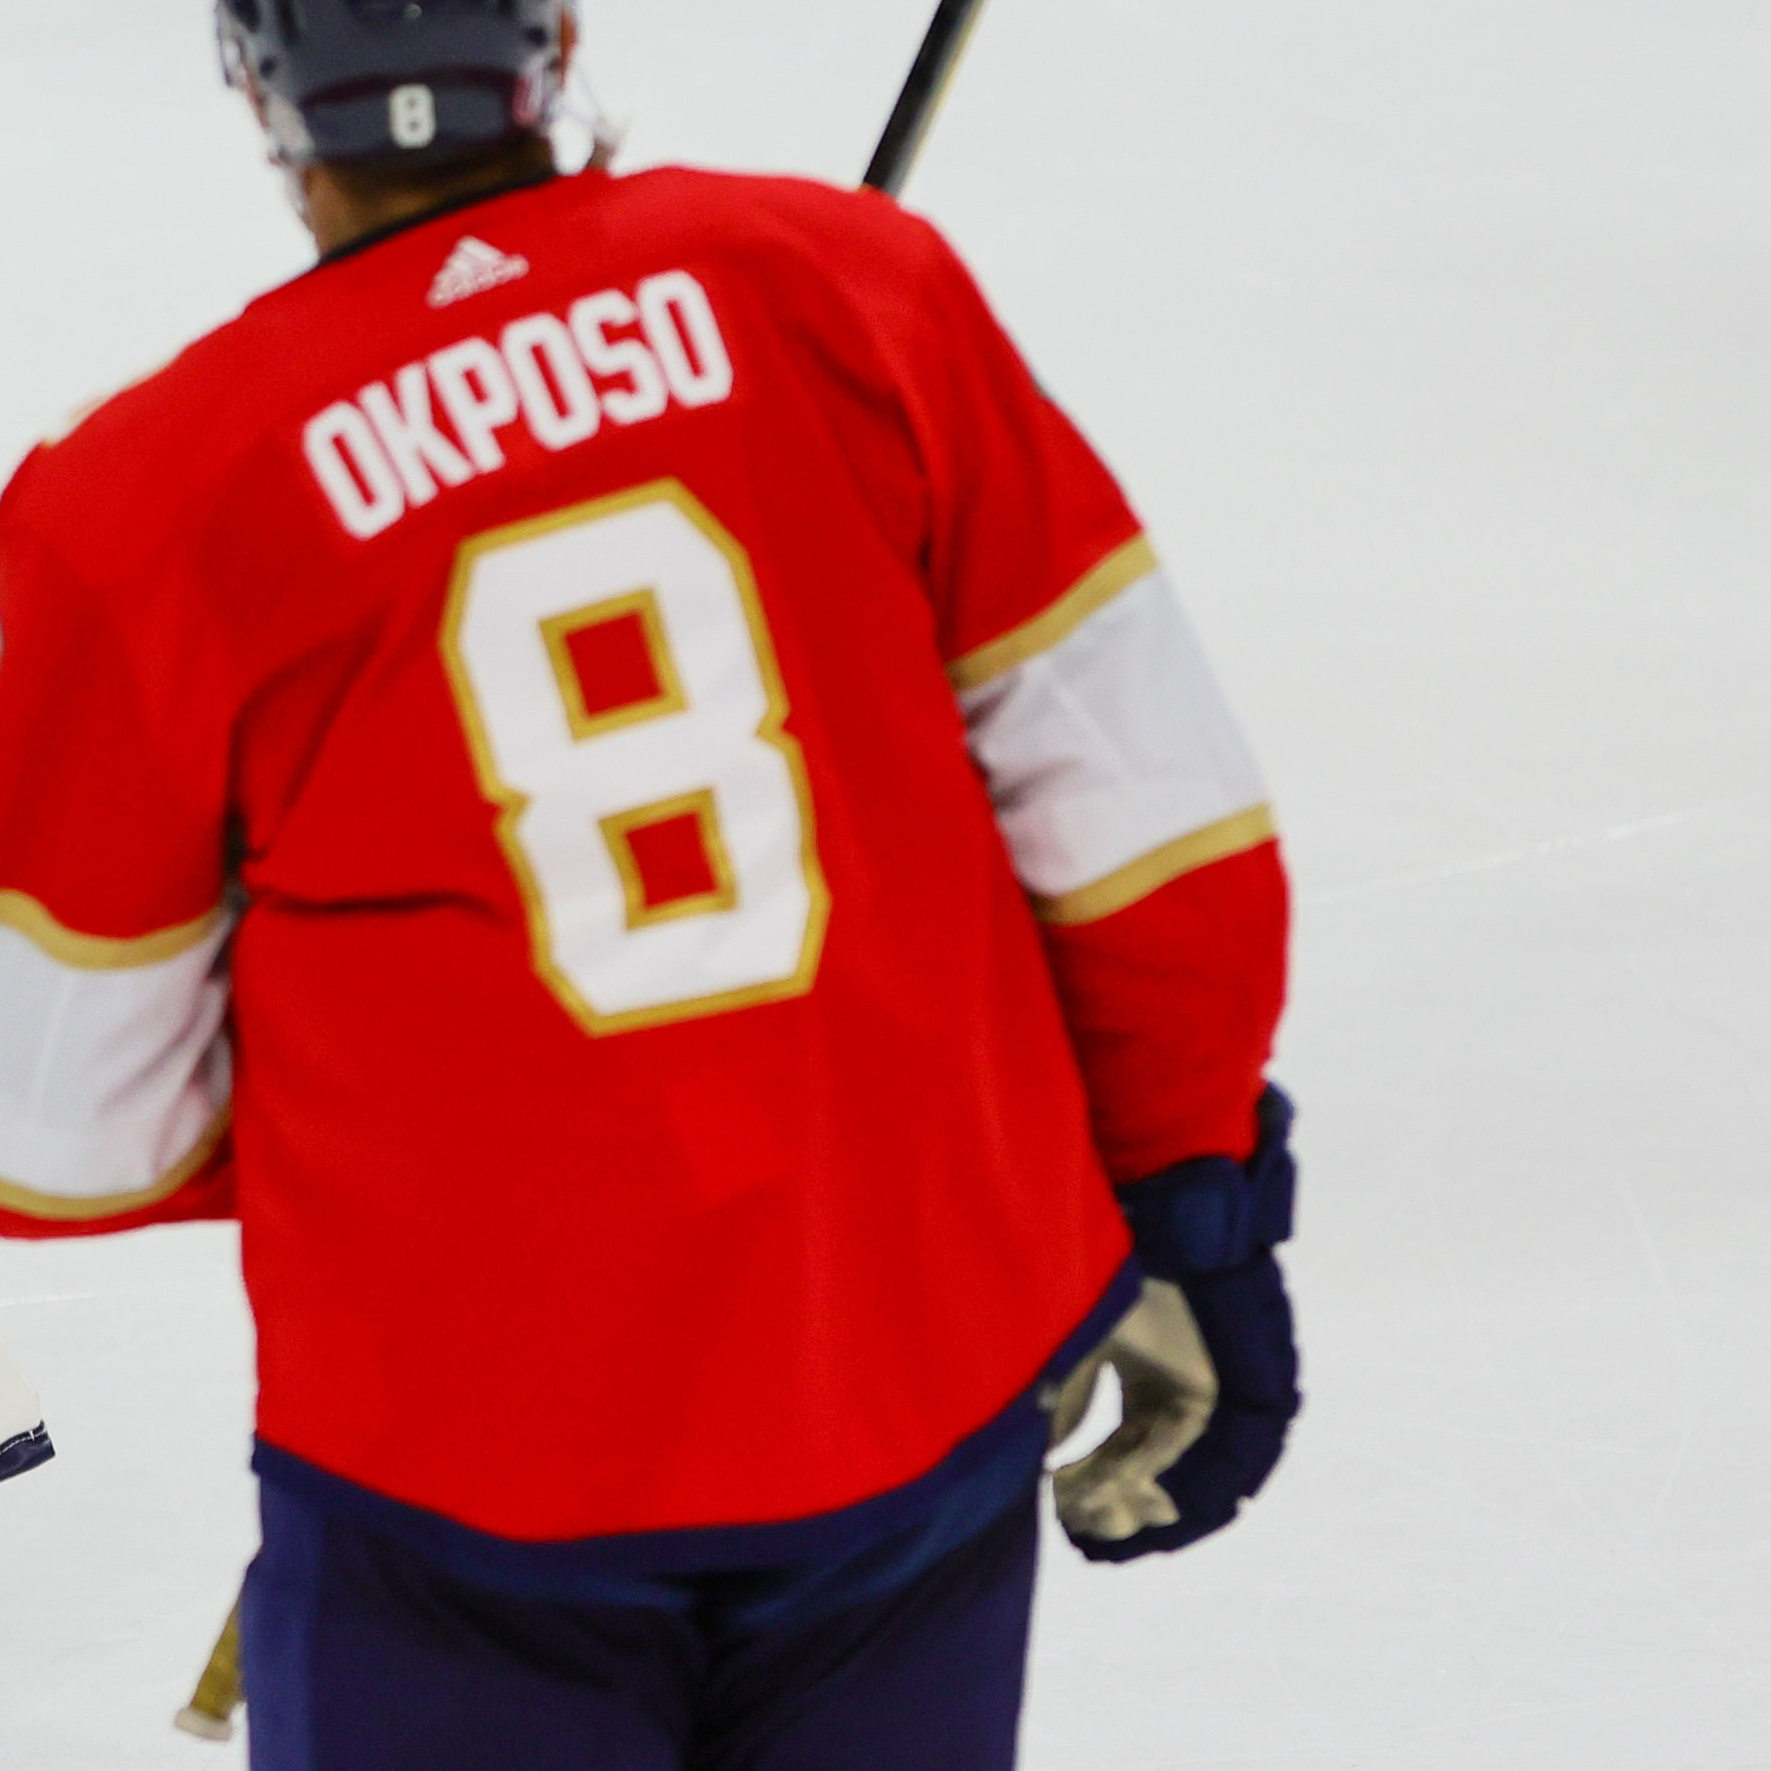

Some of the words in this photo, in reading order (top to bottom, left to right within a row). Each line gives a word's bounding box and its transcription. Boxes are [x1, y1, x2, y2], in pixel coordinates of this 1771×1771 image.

[388, 83, 436, 149] 8
[301, 270, 735, 541] OKPOSO
[440, 477, 831, 1038] 8
